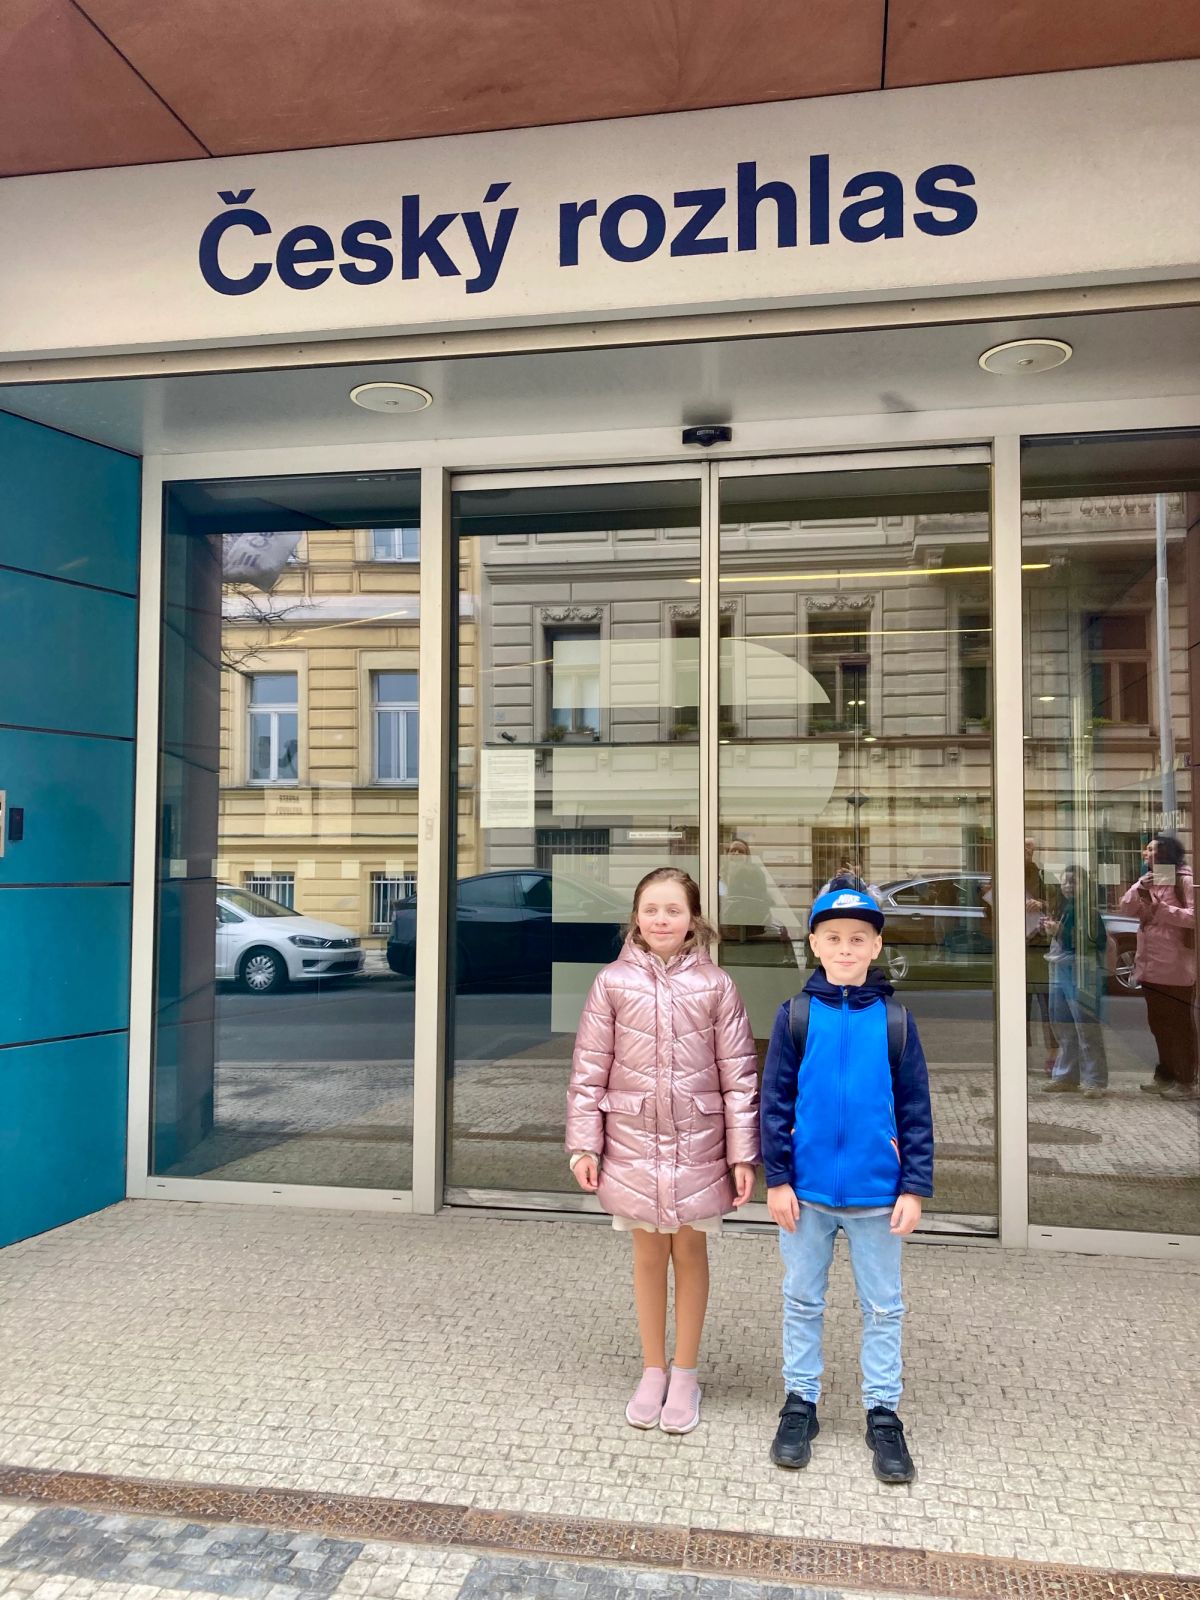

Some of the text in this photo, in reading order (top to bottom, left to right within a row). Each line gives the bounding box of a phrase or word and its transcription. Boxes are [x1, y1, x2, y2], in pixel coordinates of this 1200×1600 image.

[199, 154, 978, 296] Český rozhlas
[838, 894, 861, 904] NIKE
